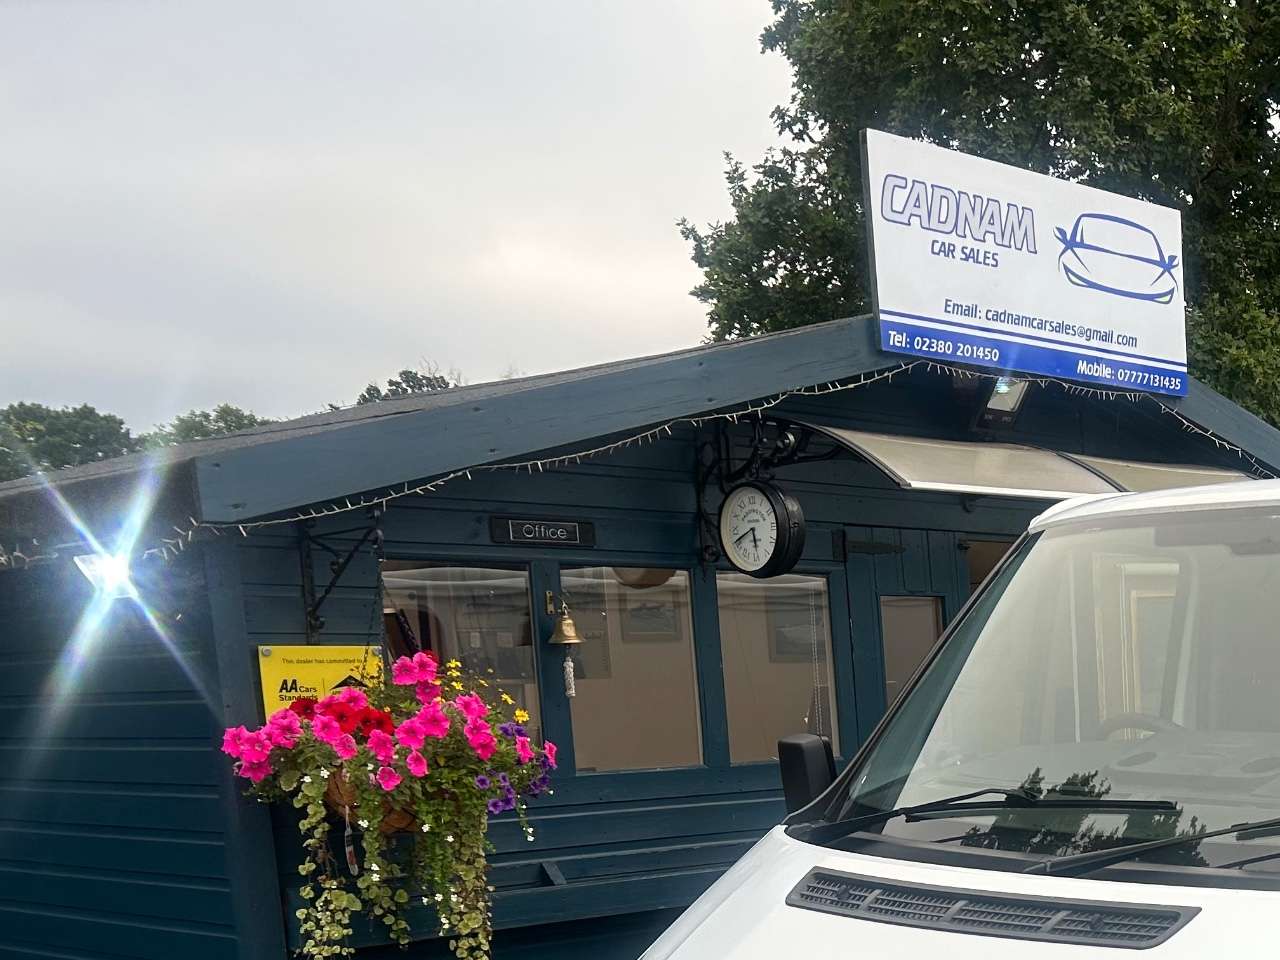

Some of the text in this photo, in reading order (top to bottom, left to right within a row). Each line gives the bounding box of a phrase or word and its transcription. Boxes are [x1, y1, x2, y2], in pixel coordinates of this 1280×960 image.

[881, 174, 1037, 254] CADNAM
[931, 240, 998, 268] CAR SALES
[944, 299, 1138, 348] Email: cadnamcarsales@gmail.com
[888, 331, 1000, 362] Tel: 02380 201450
[1077, 361, 1182, 390] Mobile: 07777131435
[522, 524, 568, 538] Office
[278, 679, 298, 692] AA
